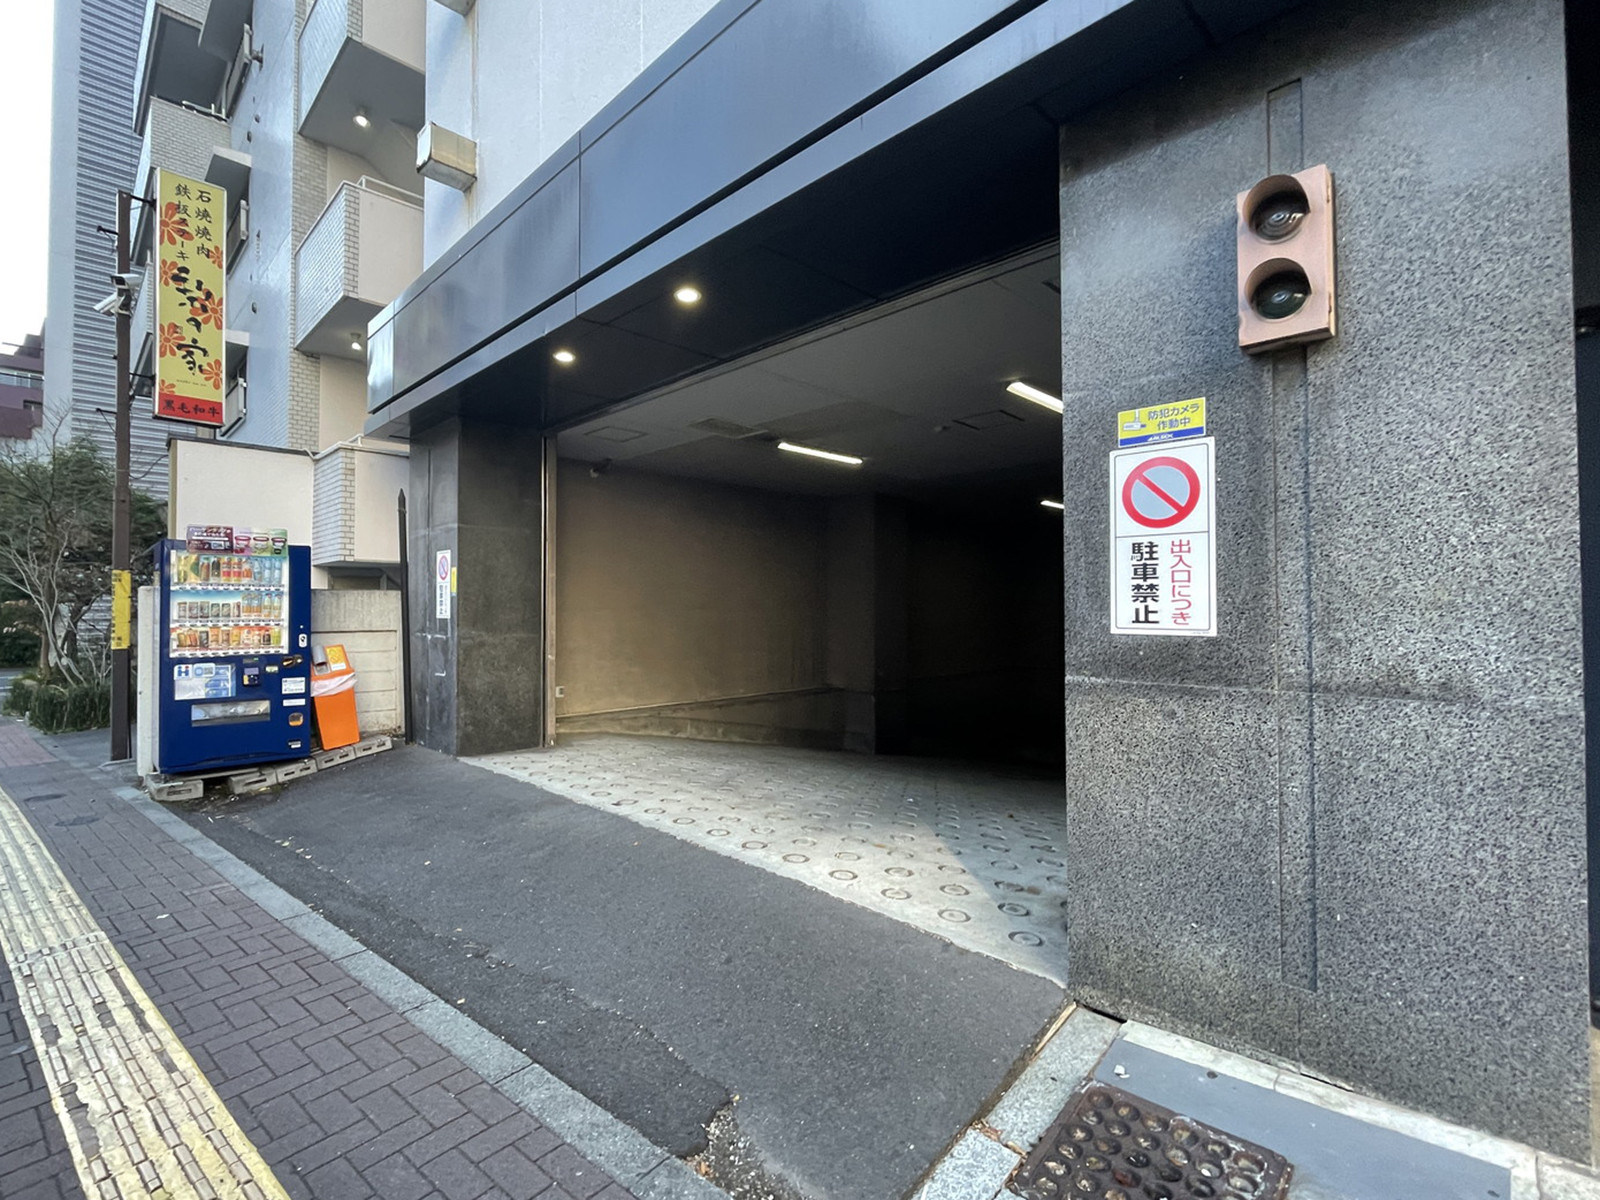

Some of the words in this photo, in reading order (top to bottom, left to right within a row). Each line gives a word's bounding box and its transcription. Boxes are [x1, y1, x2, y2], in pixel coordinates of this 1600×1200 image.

[162, 399, 220, 418] 黒毛和牛
[1148, 403, 1200, 421] 防犯カメラ
[1157, 416, 1191, 431] 作動中
[1130, 540, 1161, 625] 駐車禁止
[1170, 539, 1193, 626] 出入口につき
